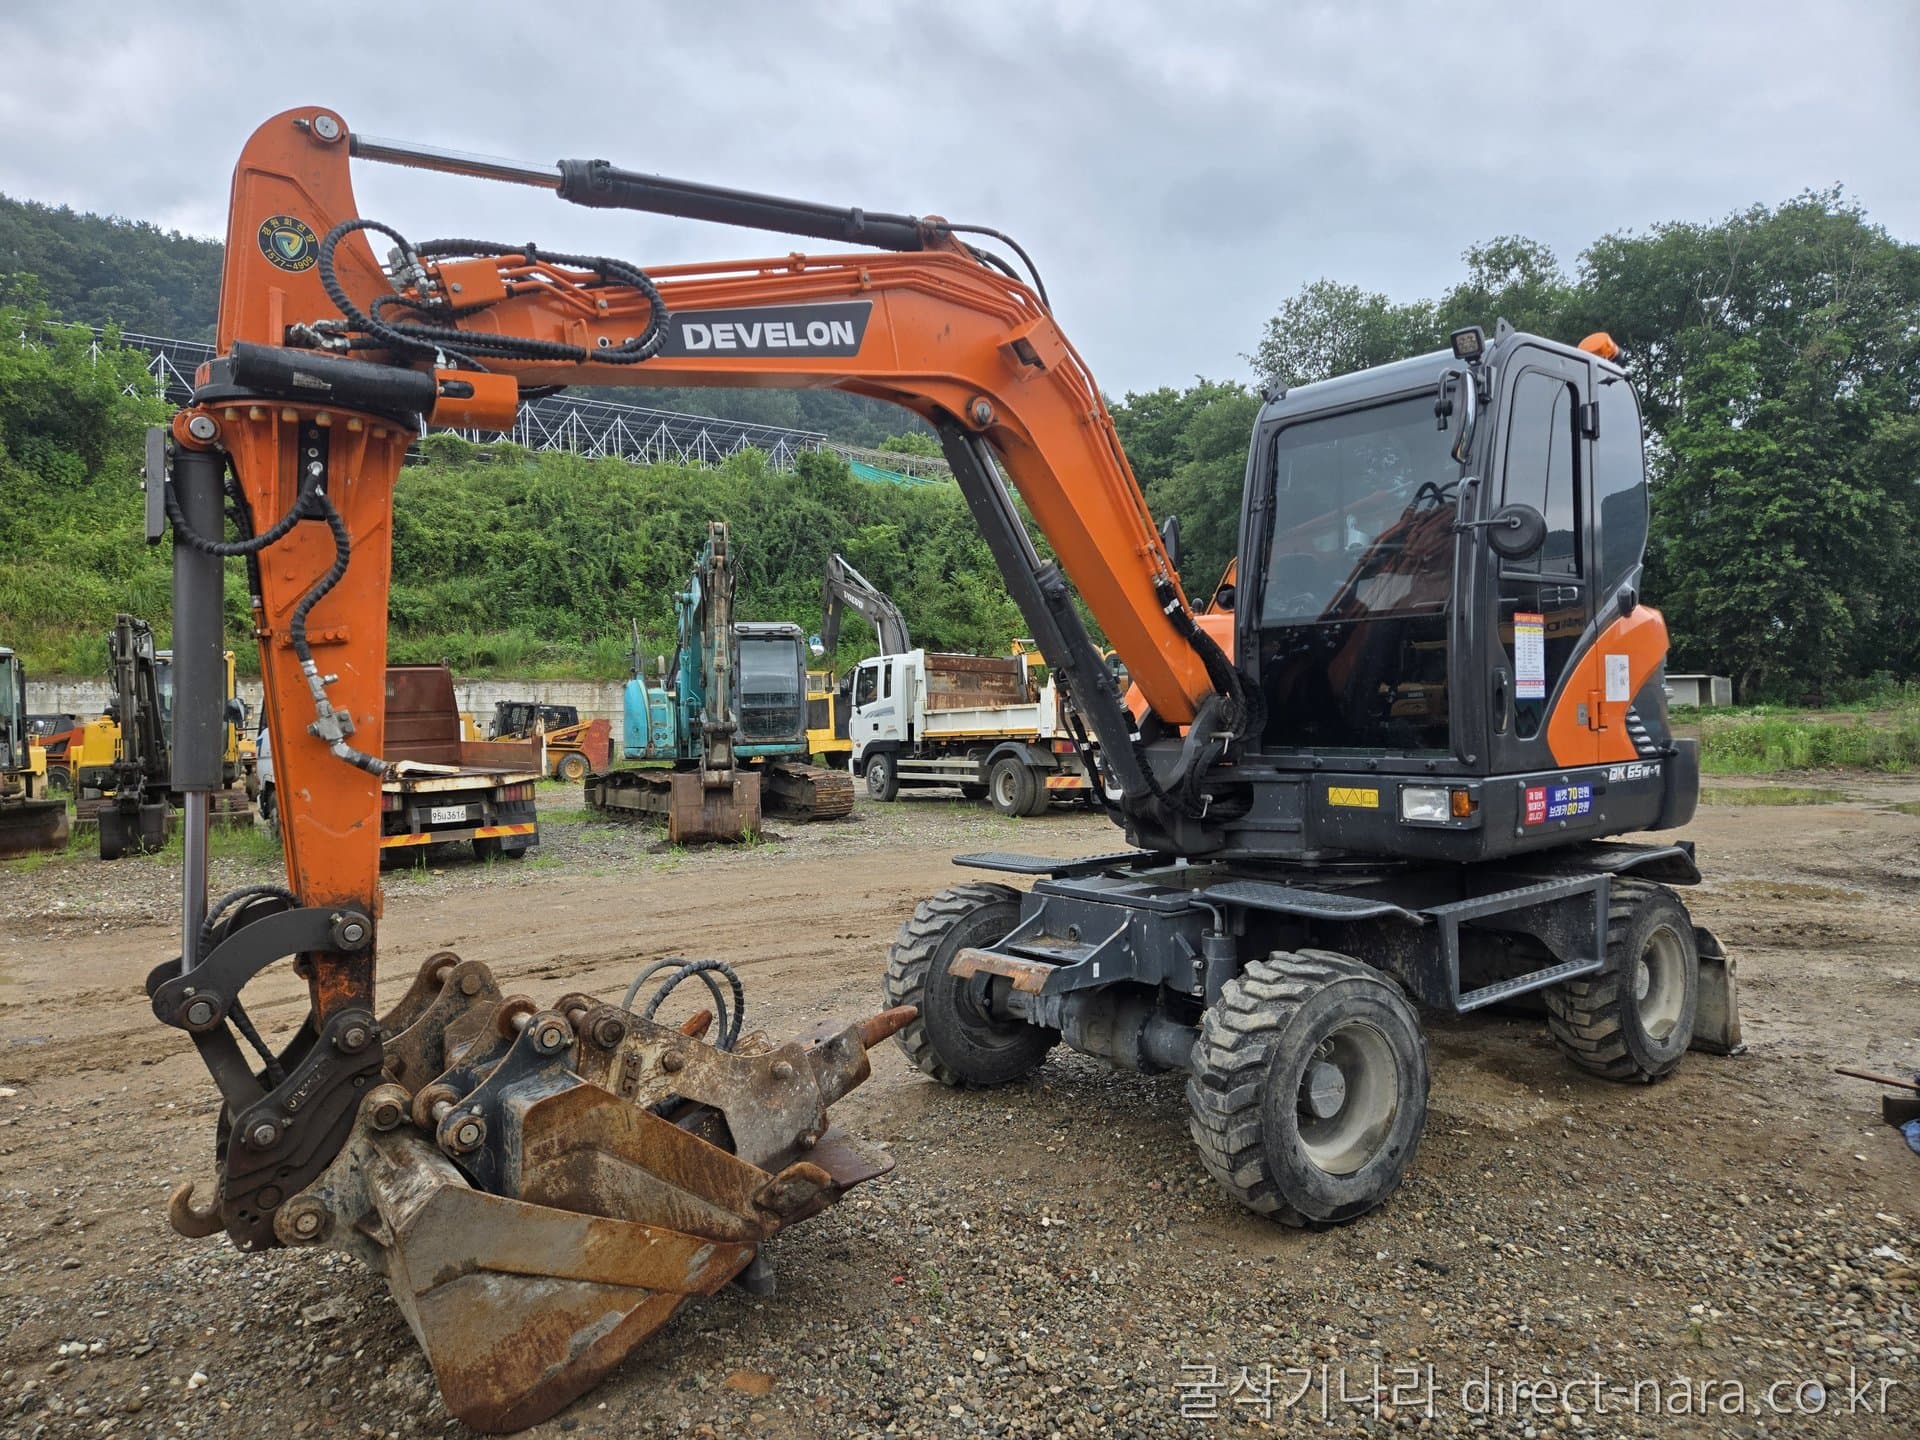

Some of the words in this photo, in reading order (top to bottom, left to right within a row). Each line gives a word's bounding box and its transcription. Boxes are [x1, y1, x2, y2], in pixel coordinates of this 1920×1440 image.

[264, 248, 314, 270] 1577-4909
[681, 320, 855, 350] DEVELON
[843, 590, 864, 609] VOLVO
